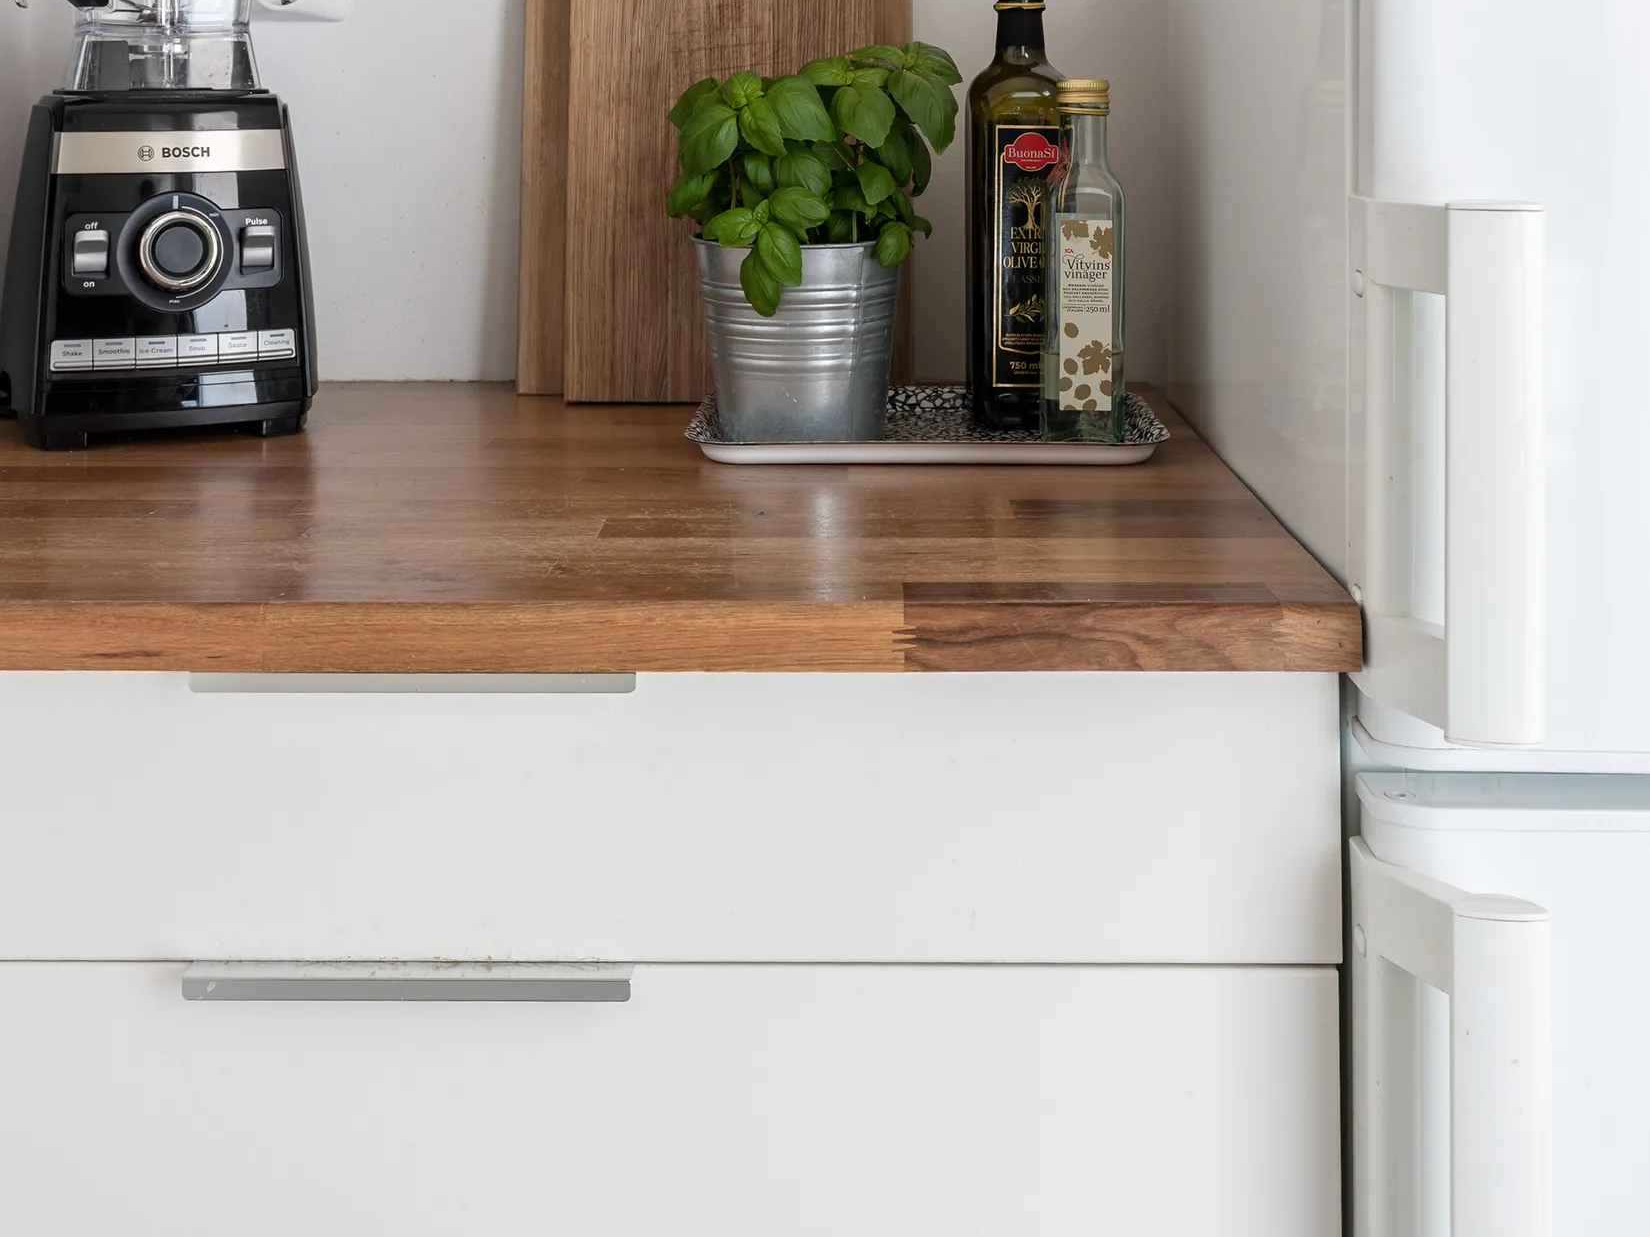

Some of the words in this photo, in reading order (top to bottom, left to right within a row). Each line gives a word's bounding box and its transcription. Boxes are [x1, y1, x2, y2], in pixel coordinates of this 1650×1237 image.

[162, 146, 210, 158] BOSCH
[1008, 147, 1055, 159] BuonaSí
[84, 222, 99, 230] off
[245, 217, 268, 225] Pulse
[1010, 226, 1044, 240] EXTR
[1010, 241, 1045, 254] VIRGI
[1003, 256, 1038, 268] OLIVE
[1064, 255, 1110, 270] Vitvins
[1064, 269, 1107, 282] vinäger
[1085, 306, 1098, 314] 250
[1099, 304, 1110, 312] ml
[1009, 361, 1027, 369] 750
